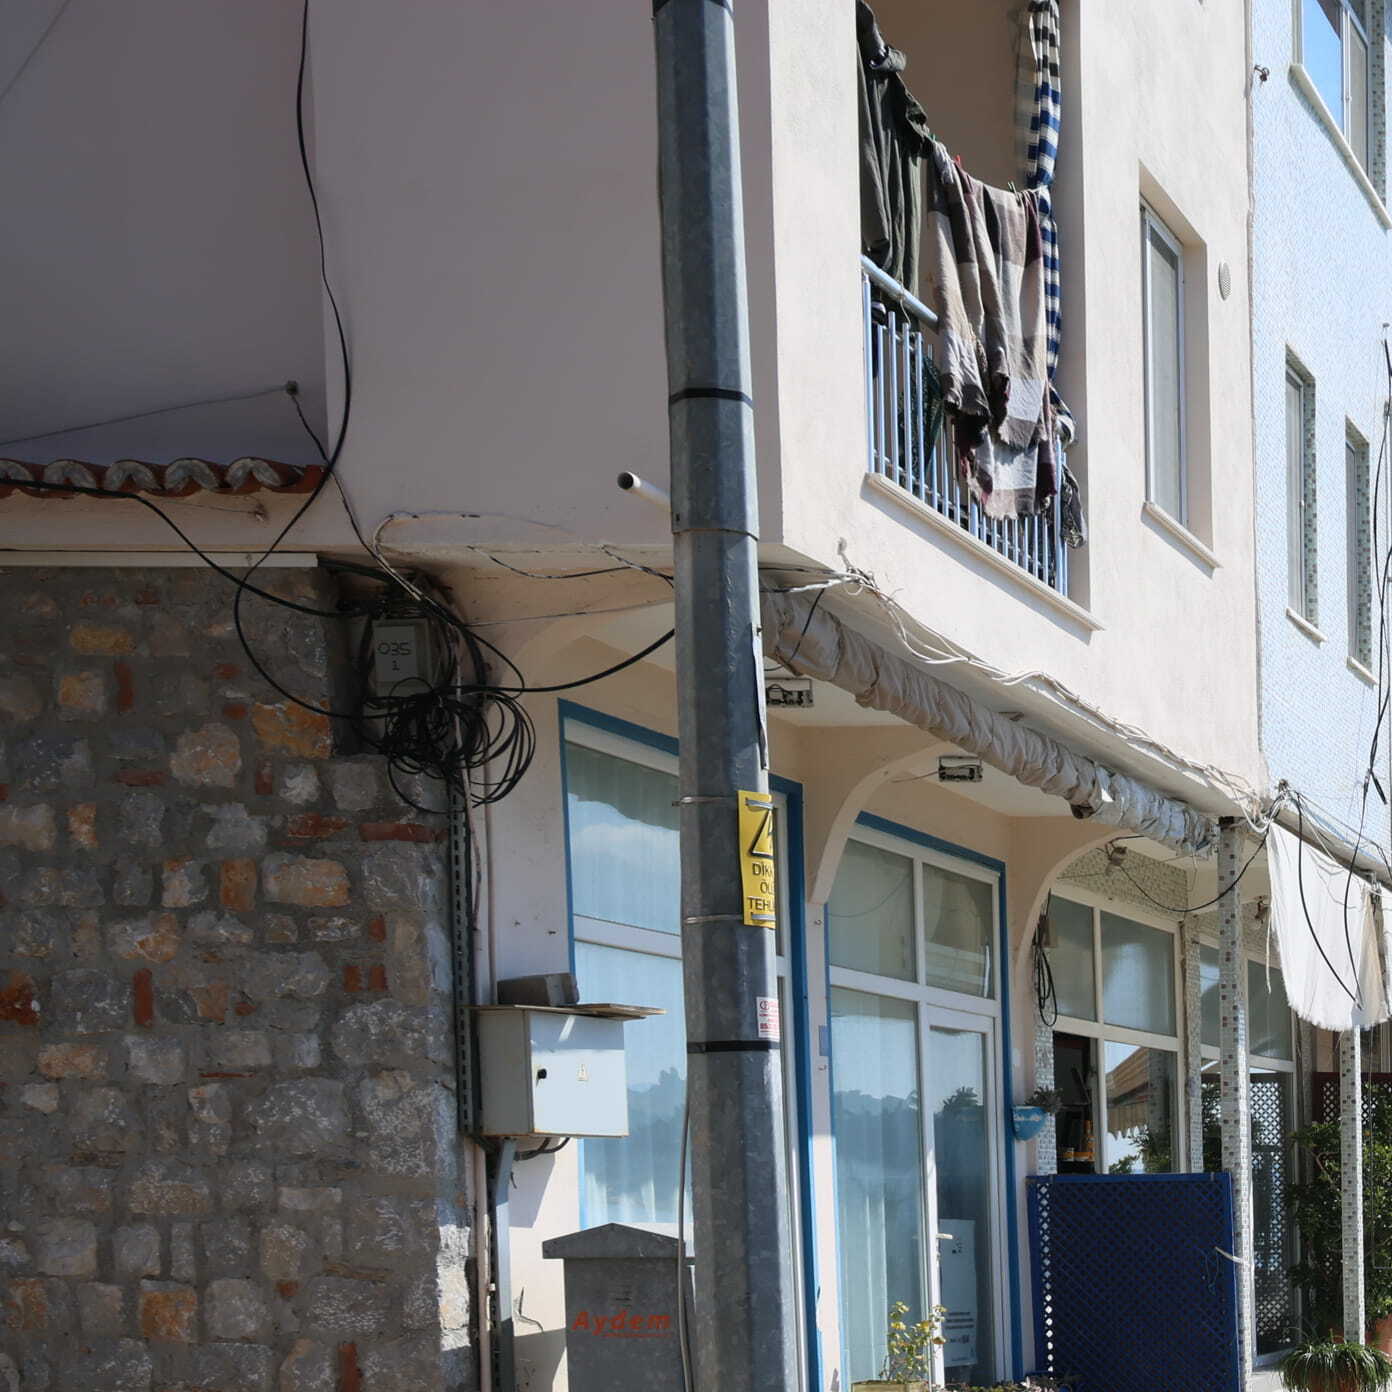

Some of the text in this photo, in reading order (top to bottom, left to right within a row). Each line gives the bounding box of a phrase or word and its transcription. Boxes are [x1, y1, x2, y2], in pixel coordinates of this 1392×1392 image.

[759, 878, 775, 895] ÖL
[747, 897, 775, 912] TEHL
[571, 1309, 672, 1337] Aydem
